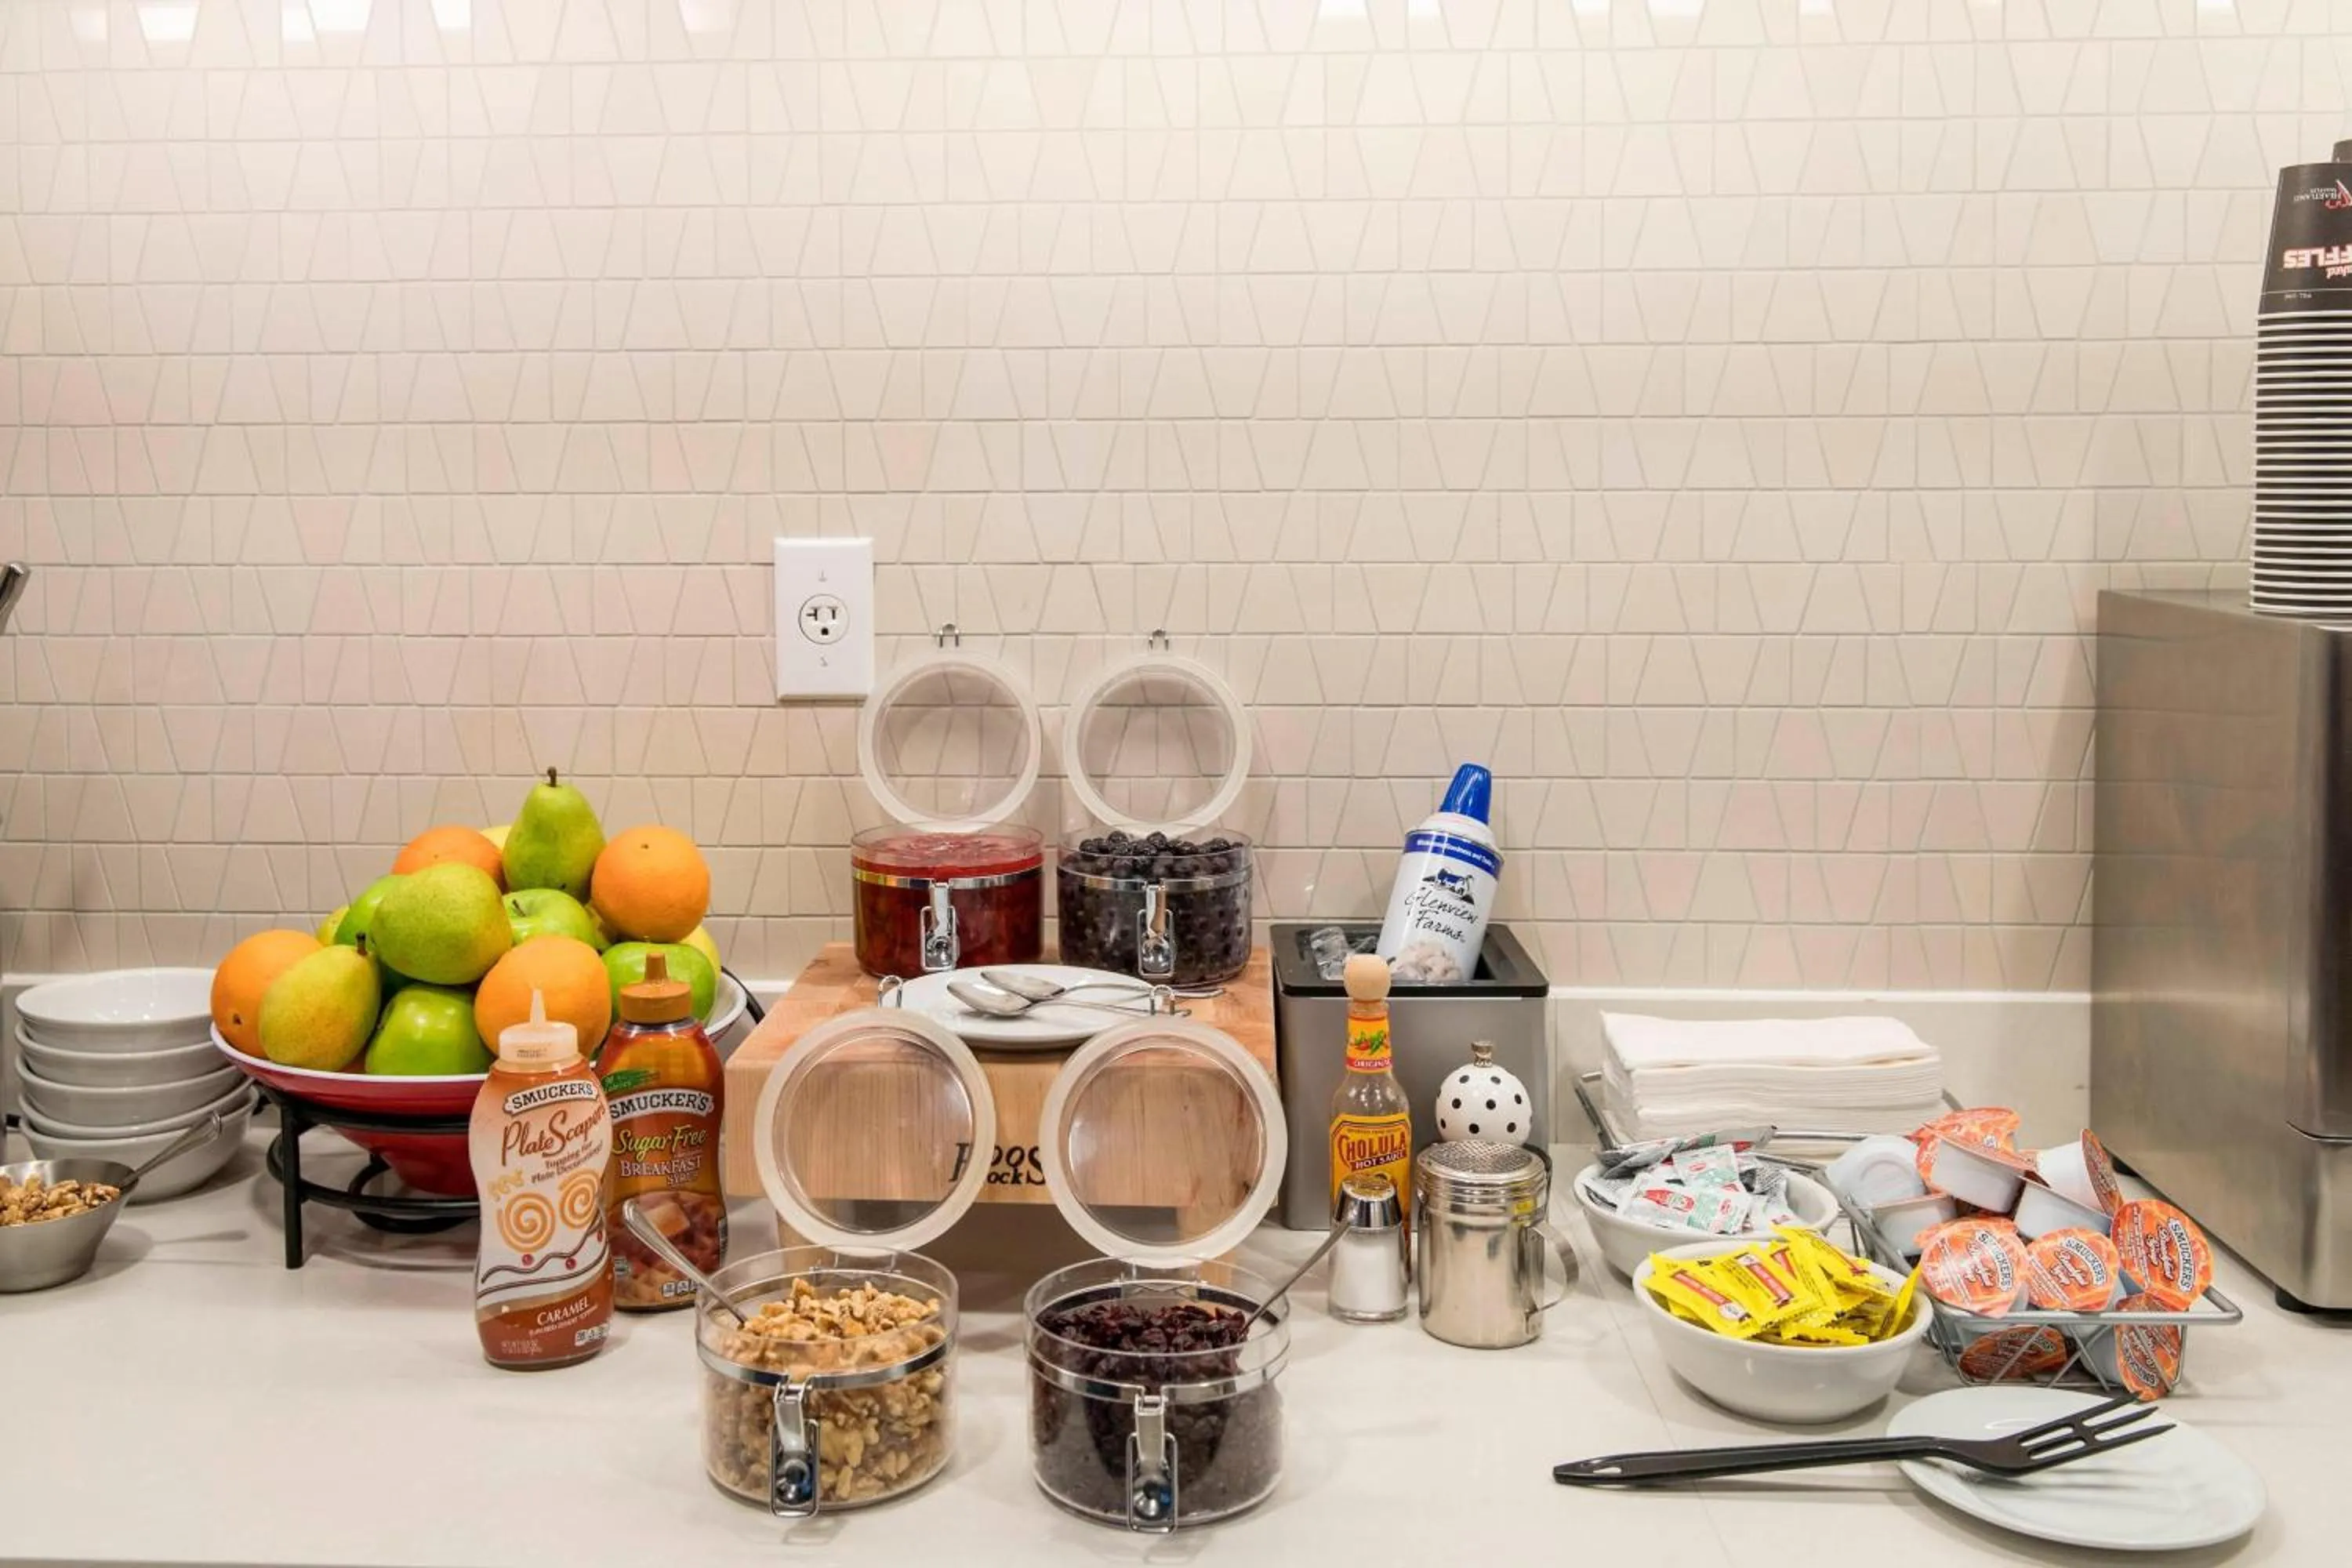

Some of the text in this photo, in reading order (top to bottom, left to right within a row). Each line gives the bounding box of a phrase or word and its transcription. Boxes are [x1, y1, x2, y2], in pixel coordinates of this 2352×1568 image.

[1404, 889, 1479, 924] Glenview
[1415, 909, 1464, 940] Farms
[609, 1093, 709, 1119] SMUCKER'S
[612, 1123, 709, 1163] Sugar Free
[1338, 1131, 1407, 1168] CHOLULA
[621, 1156, 701, 1177] BREAKFAST
[1356, 1149, 1404, 1170] HOT SAUCE
[537, 1296, 589, 1326] CARAMEL
